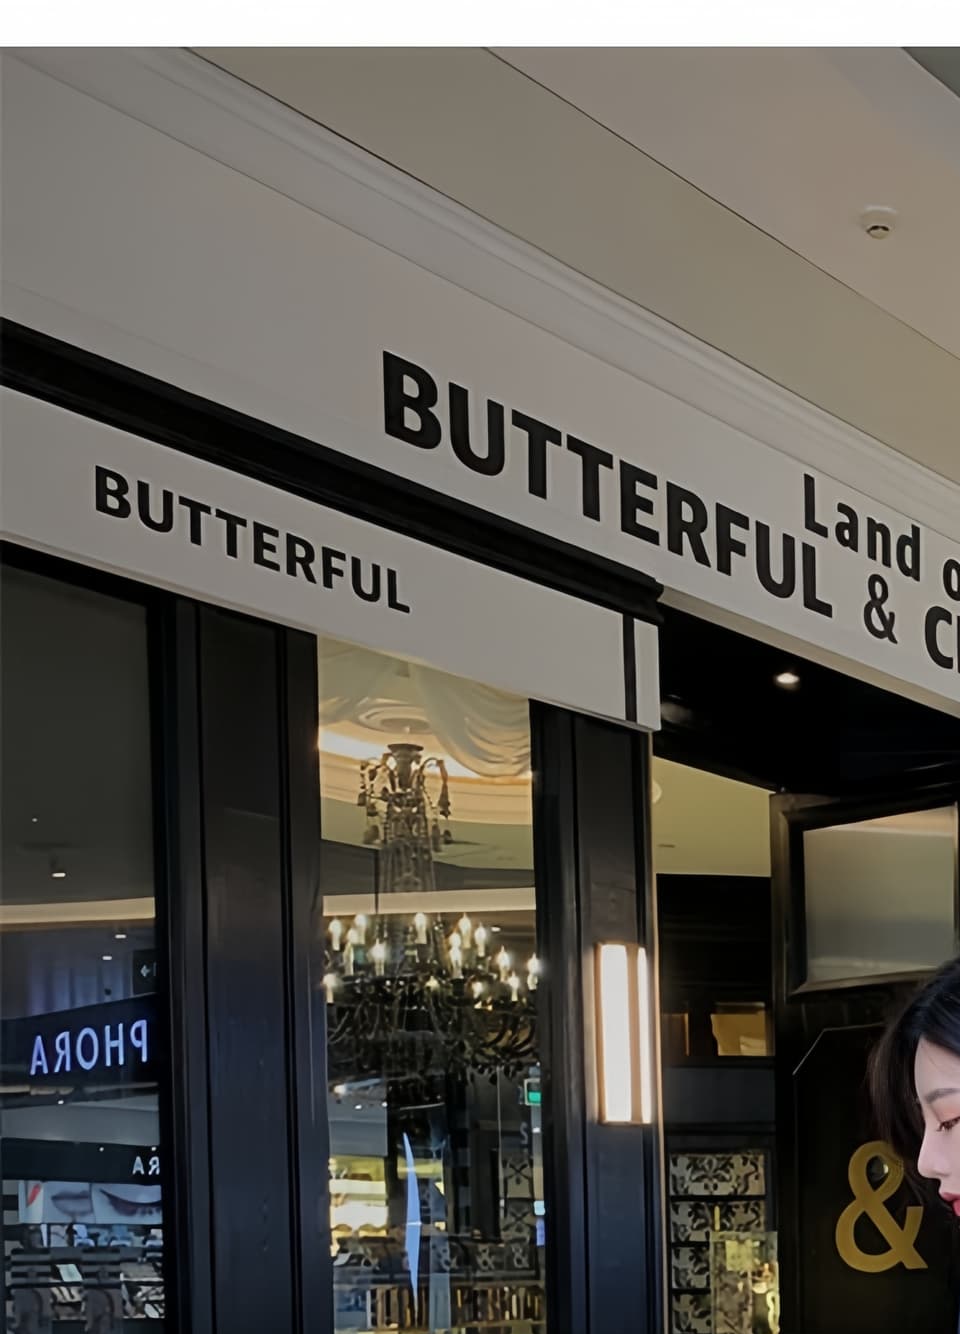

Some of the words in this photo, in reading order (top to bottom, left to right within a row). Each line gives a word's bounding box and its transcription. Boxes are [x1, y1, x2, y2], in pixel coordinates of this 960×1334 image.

[95, 465, 410, 614] BUTTERFUL
[382, 350, 833, 618] BUTTERFUL
[862, 573, 898, 644] &
[803, 473, 921, 582] Land
[835, 1140, 929, 1274] &
